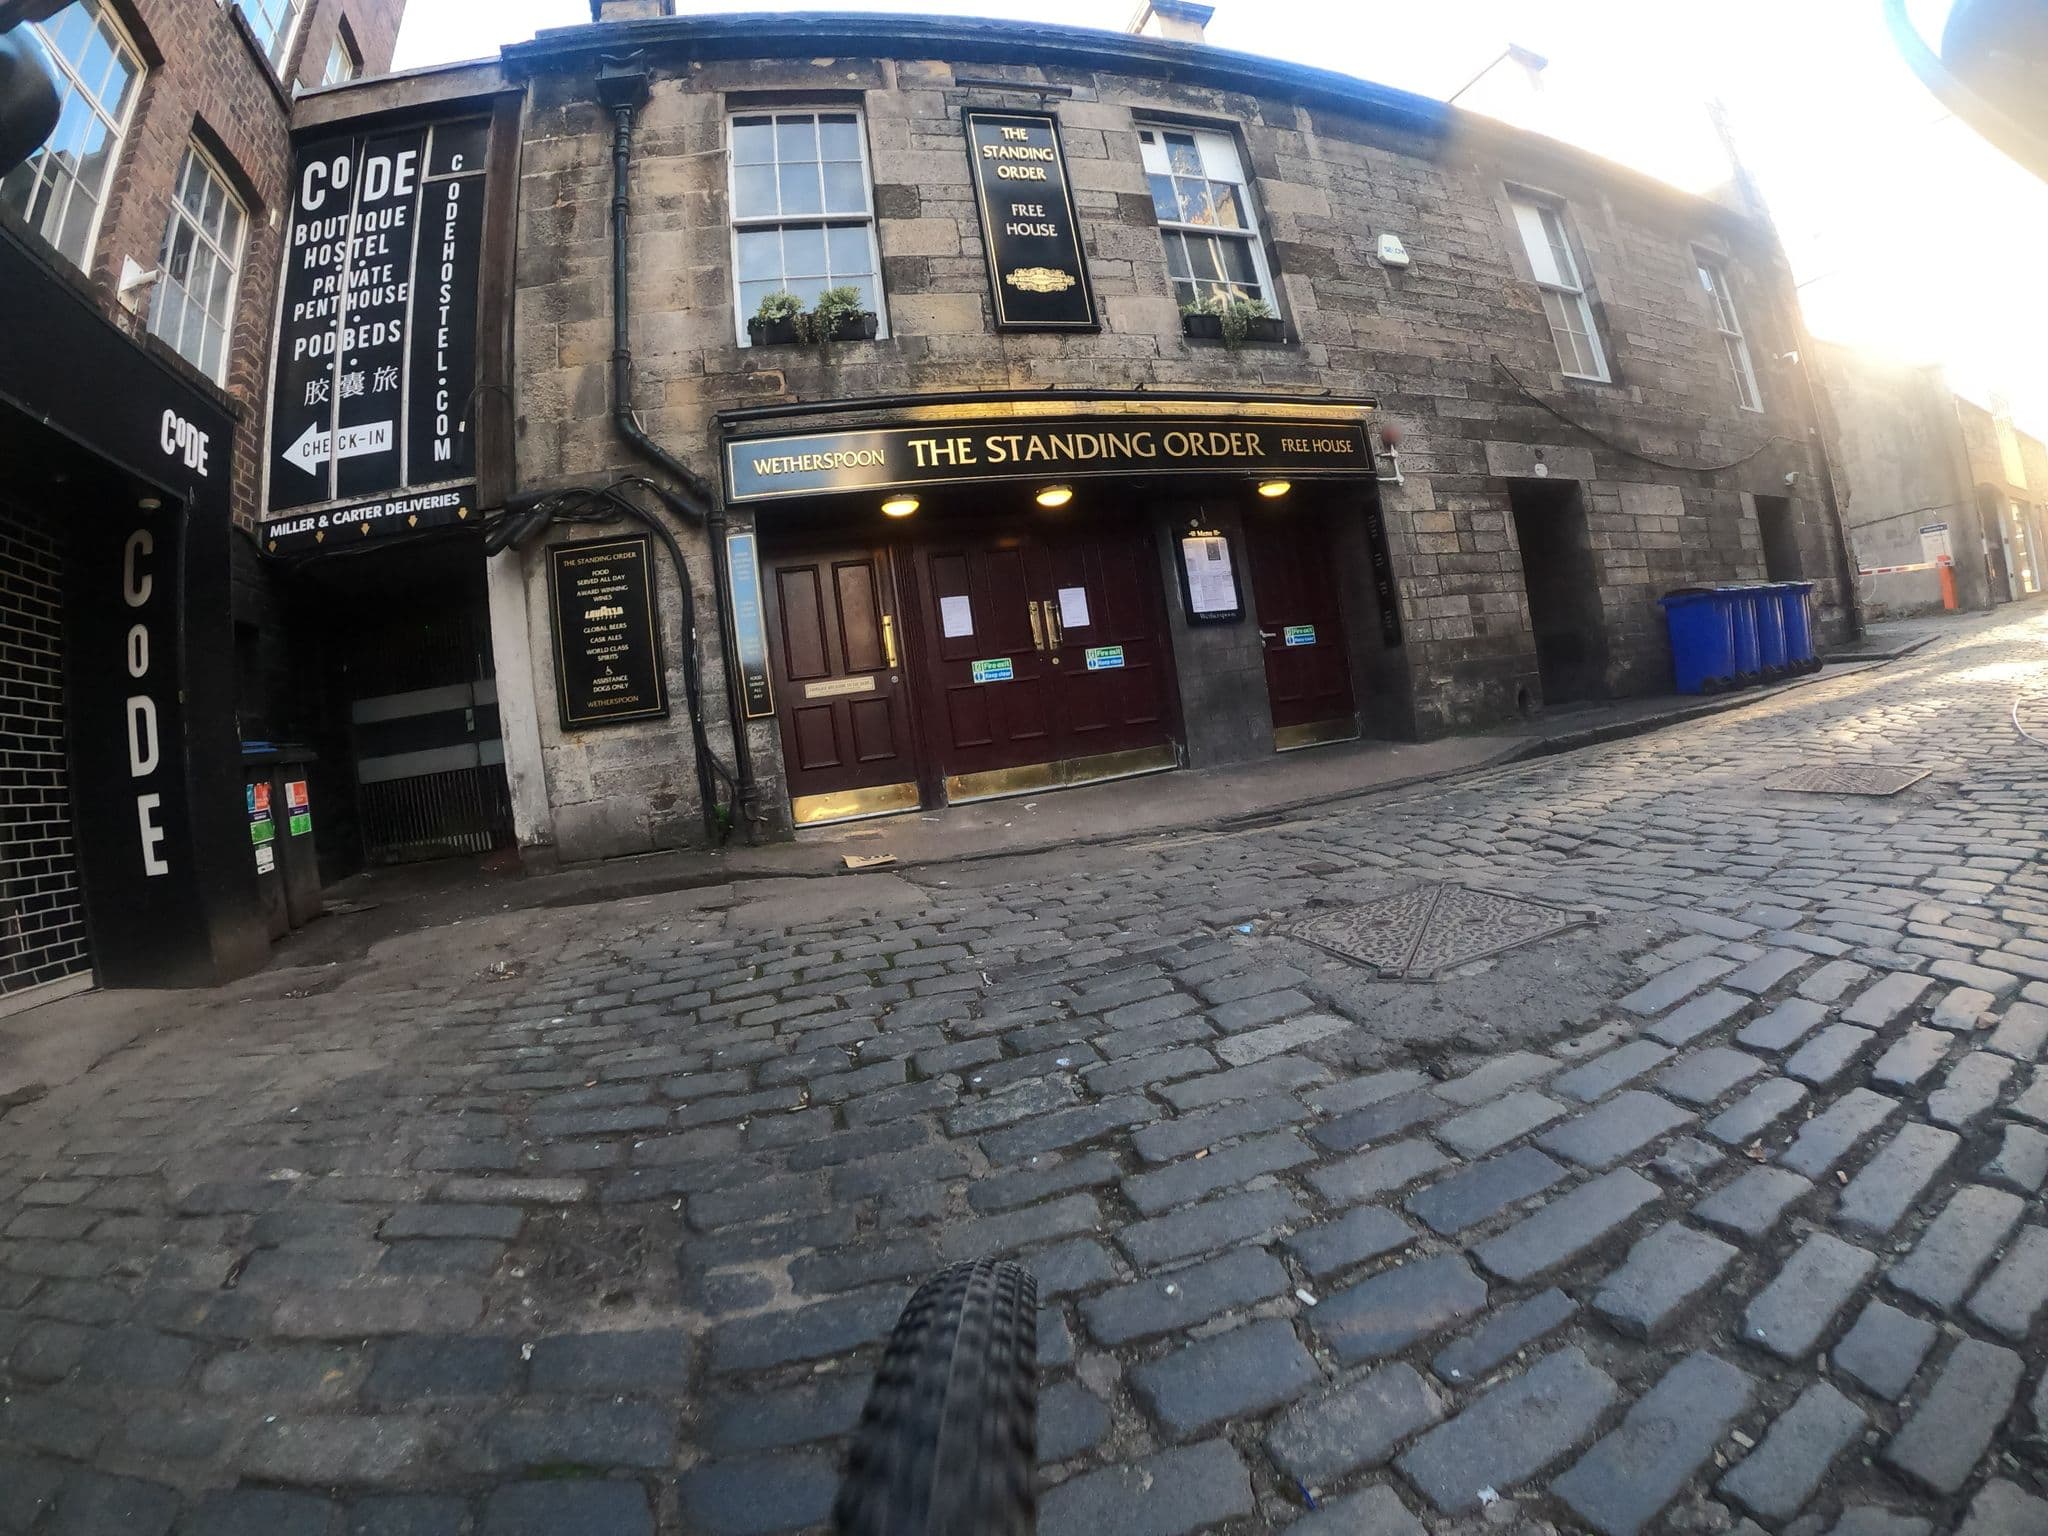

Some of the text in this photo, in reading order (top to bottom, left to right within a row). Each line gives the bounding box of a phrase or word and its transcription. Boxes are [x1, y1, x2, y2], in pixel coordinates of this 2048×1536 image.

[1001, 127, 1028, 141] THE
[983, 145, 1054, 162] STANDING
[997, 166, 1046, 181] ORDER
[1011, 204, 1045, 217] FREE
[295, 205, 407, 246] BOUTIQUE
[1006, 223, 1058, 237] HOUSE
[304, 233, 389, 269] HOSTEL
[312, 264, 393, 296] PRIVATE
[294, 283, 408, 322] PENTHOUSE
[302, 428, 385, 457] CHECK-IN
[753, 432, 1354, 475] WETHERSPOON THE STANDING ORDER FREE HOUSE
[270, 492, 460, 538] MILLER & CARTER DELIVERIES
[563, 551, 637, 568] THE STANDING ORDER
[592, 568, 609, 576] FOOD
[577, 577, 599, 586] SERVED
[600, 575, 611, 583] ALL
[576, 585, 628, 597] AWARD WINNING
[593, 594, 612, 602] WINES
[583, 622, 627, 634] GLOBAL BEERS
[589, 634, 622, 644] CASK ALES
[586, 644, 629, 656] WORLD CLASS
[597, 654, 619, 662] SPIRITS
[984, 660, 1010, 670] Fire exit
[592, 675, 629, 685] ASSISTANCE
[593, 682, 629, 693] DOGS ONLY
[587, 695, 639, 708] WETHERSPOON
